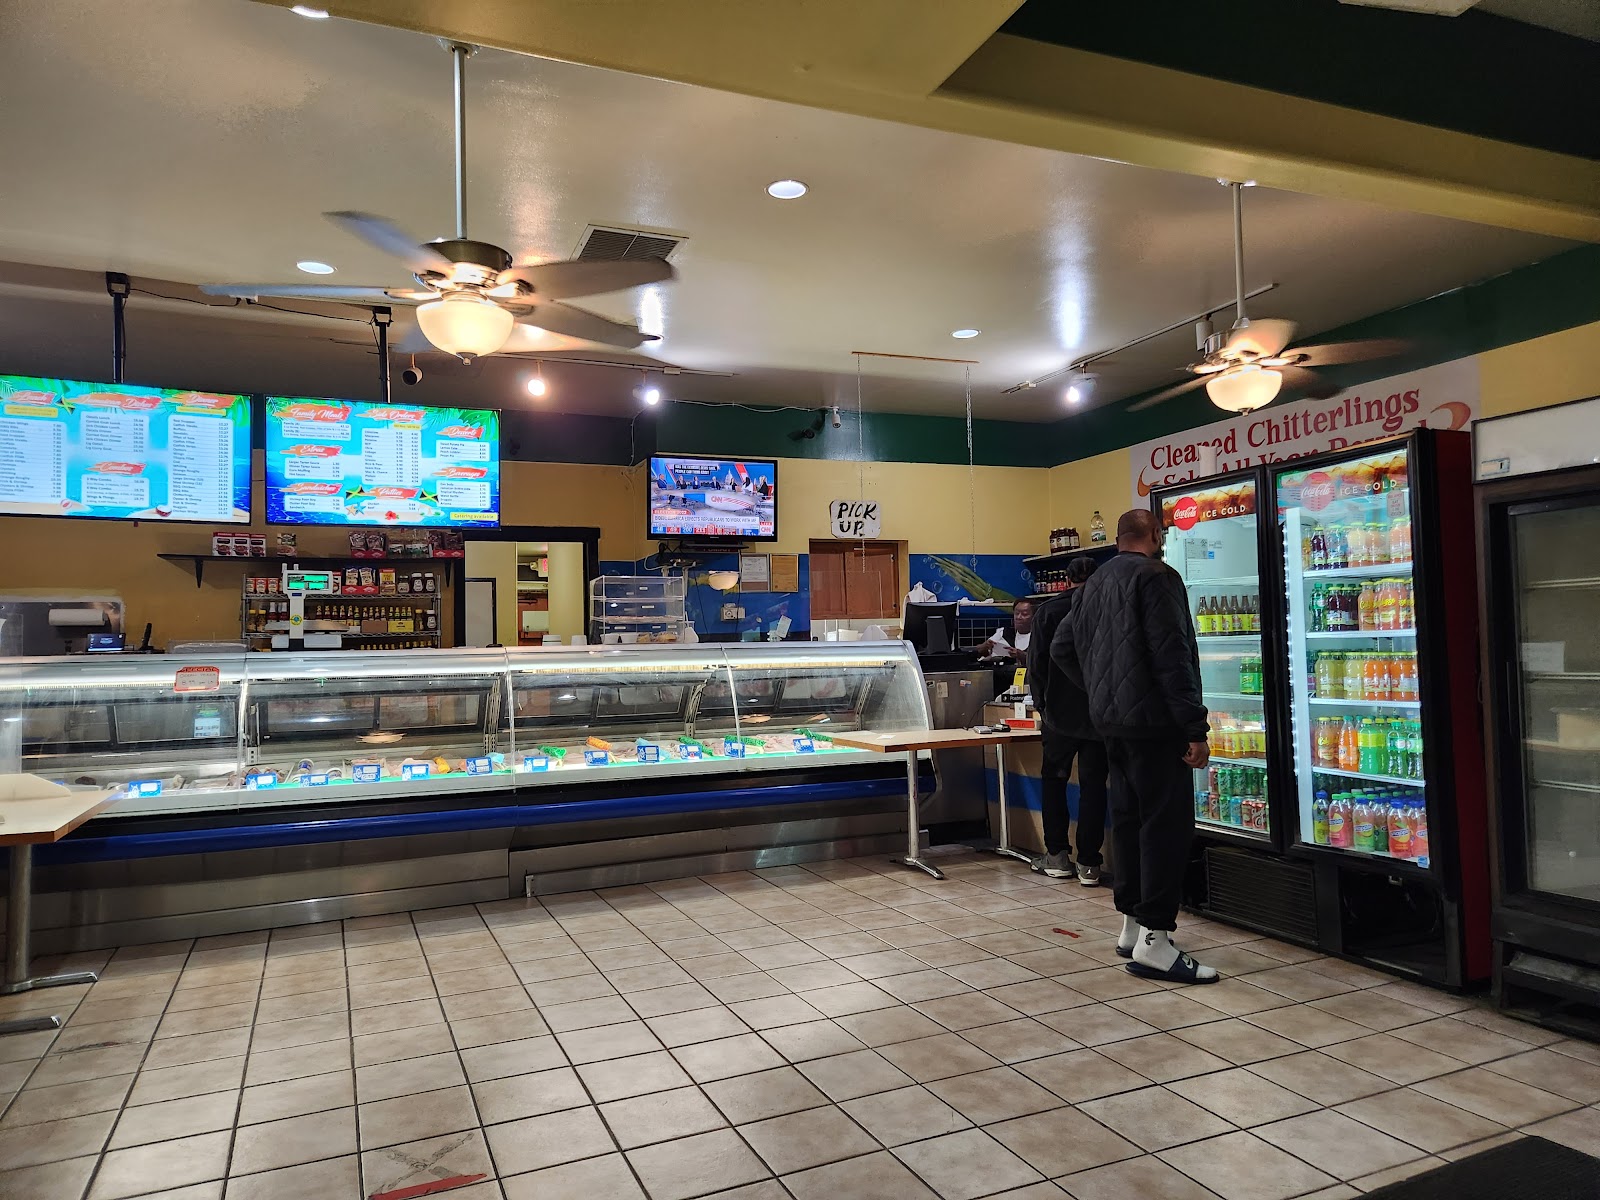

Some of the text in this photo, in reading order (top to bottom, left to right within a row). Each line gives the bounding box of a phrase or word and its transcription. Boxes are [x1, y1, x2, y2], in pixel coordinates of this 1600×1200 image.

[291, 408, 344, 419] Family Meals
[372, 410, 416, 420] Side Orders
[1248, 388, 1420, 447] Chitterlings
[448, 425, 477, 436] Desserts
[301, 444, 325, 453] Extras
[449, 469, 481, 478] Beverages
[294, 483, 336, 492] Sandwiches
[1300, 482, 1332, 498] Coca-Cola
[1340, 480, 1397, 496] ICE COLD
[837, 502, 876, 520] PICK
[1174, 506, 1198, 520] Coca-Cola
[1202, 505, 1246, 518] ICE COLD
